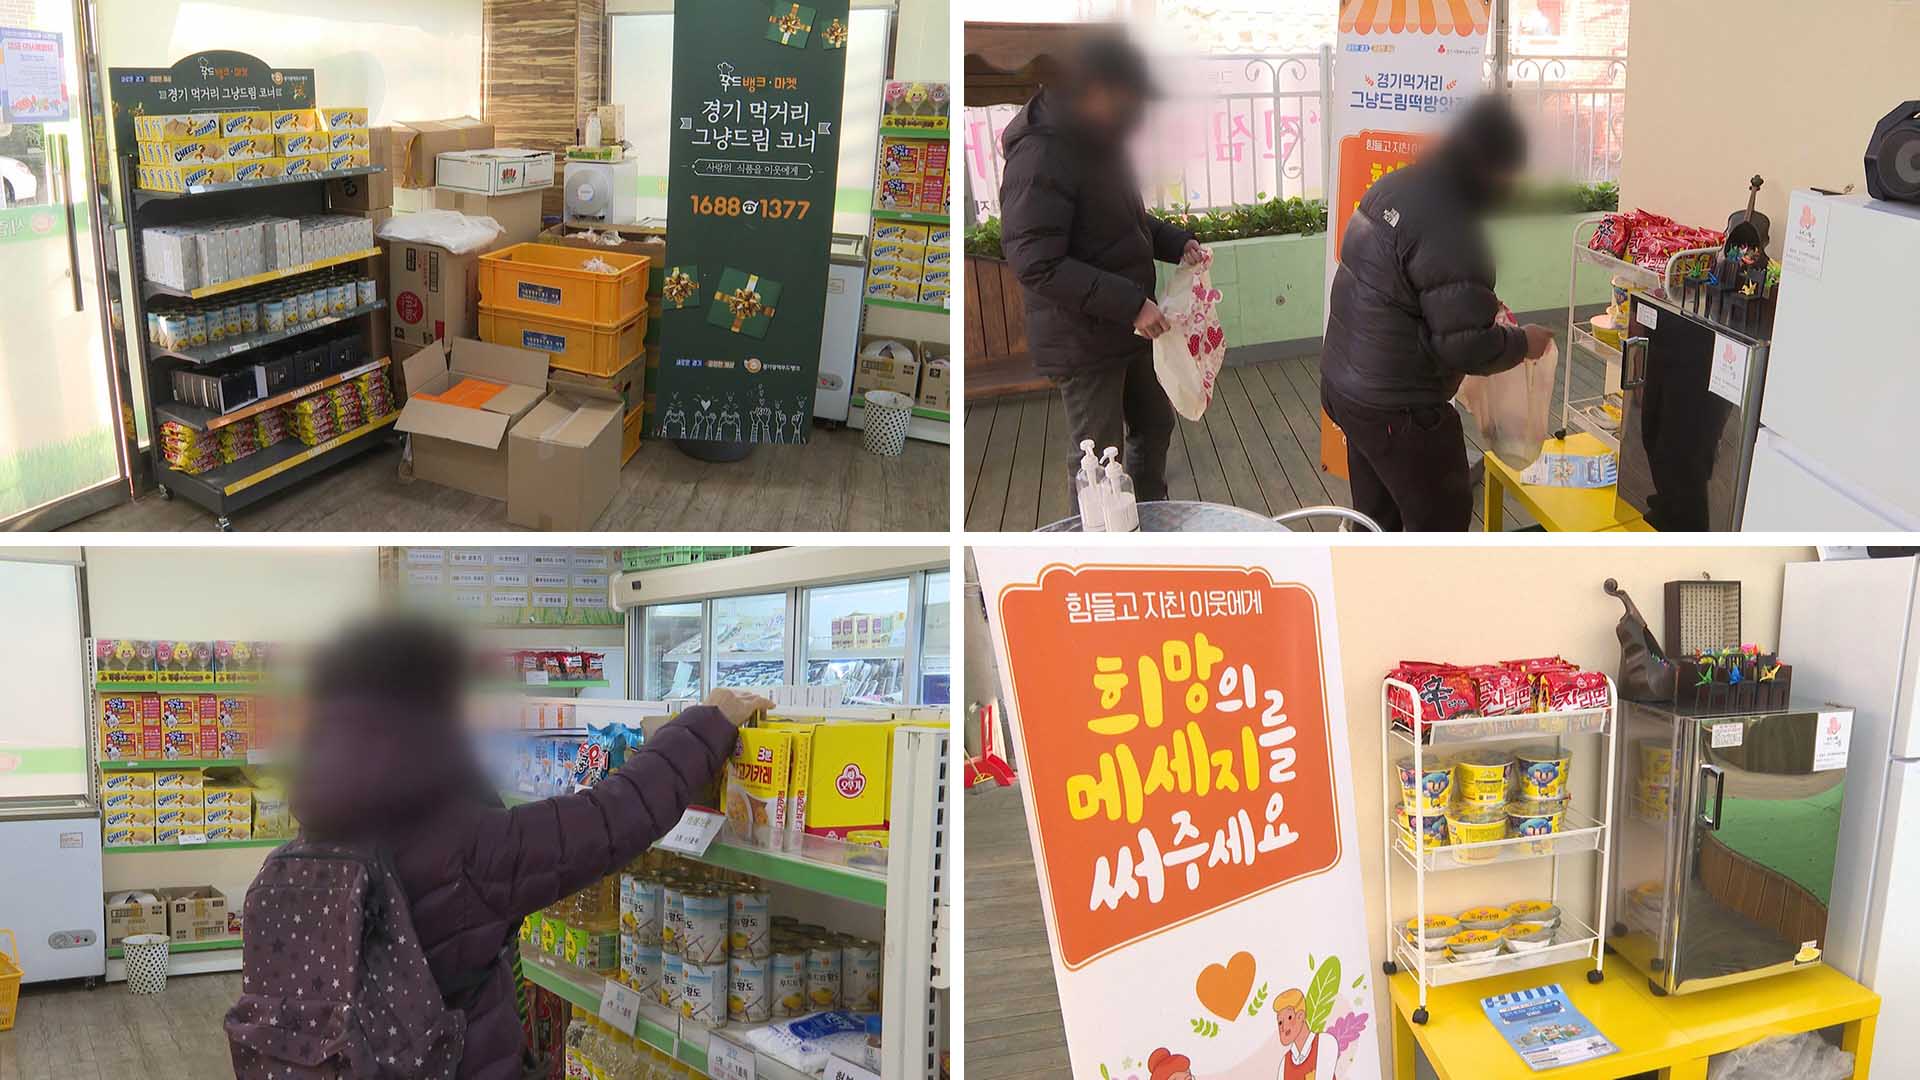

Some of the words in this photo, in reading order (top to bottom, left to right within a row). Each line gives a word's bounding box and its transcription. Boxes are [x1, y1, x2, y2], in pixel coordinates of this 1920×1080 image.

[1377, 72, 1443, 92] 경기먹거리
[167, 88, 188, 102] 경기
[190, 87, 219, 101] 먹거리
[222, 87, 257, 100] 그냥드림
[259, 87, 275, 99] 코너
[702, 100, 742, 125] 경기
[750, 102, 809, 126] 먹거리
[228, 139, 249, 157] CHEESE
[287, 135, 307, 153] CHEESE
[332, 132, 349, 149] CHEESE
[691, 127, 770, 152] 그냥드림
[776, 130, 817, 153] 코너
[174, 143, 198, 162] CHEESE
[286, 159, 305, 176] CHEESE
[331, 154, 349, 170] CHEESE
[705, 162, 732, 174] 사랑의
[737, 163, 763, 175] 식품을
[764, 165, 799, 177] 이웃에게
[185, 168, 207, 188] CHEESE
[236, 164, 258, 182] CHEESE
[690, 195, 741, 217] 1688
[760, 198, 811, 220] 1377
[1064, 590, 1139, 624] 힘들고
[1144, 591, 1186, 619] 지친
[1189, 589, 1263, 618] 이웃에게
[1087, 631, 1257, 736] 희망의
[1419, 673, 1455, 720] 辛
[1480, 685, 1531, 716] 진라면
[757, 746, 773, 762] 3분
[1065, 690, 1297, 824] 메세지를
[107, 776, 128, 789] CHEESE
[158, 774, 178, 787] CHEESE
[107, 796, 128, 808] CHEESE
[158, 795, 178, 807] CHEESE
[207, 793, 226, 804] CHEESE
[107, 813, 128, 825] CHEESE
[158, 813, 178, 825] CHEESE
[207, 811, 226, 822] CHEESE
[107, 831, 128, 843] CHEESE
[158, 830, 178, 842] CHEESE
[207, 828, 227, 840] CHEESE
[1089, 792, 1300, 912] 써주세요
